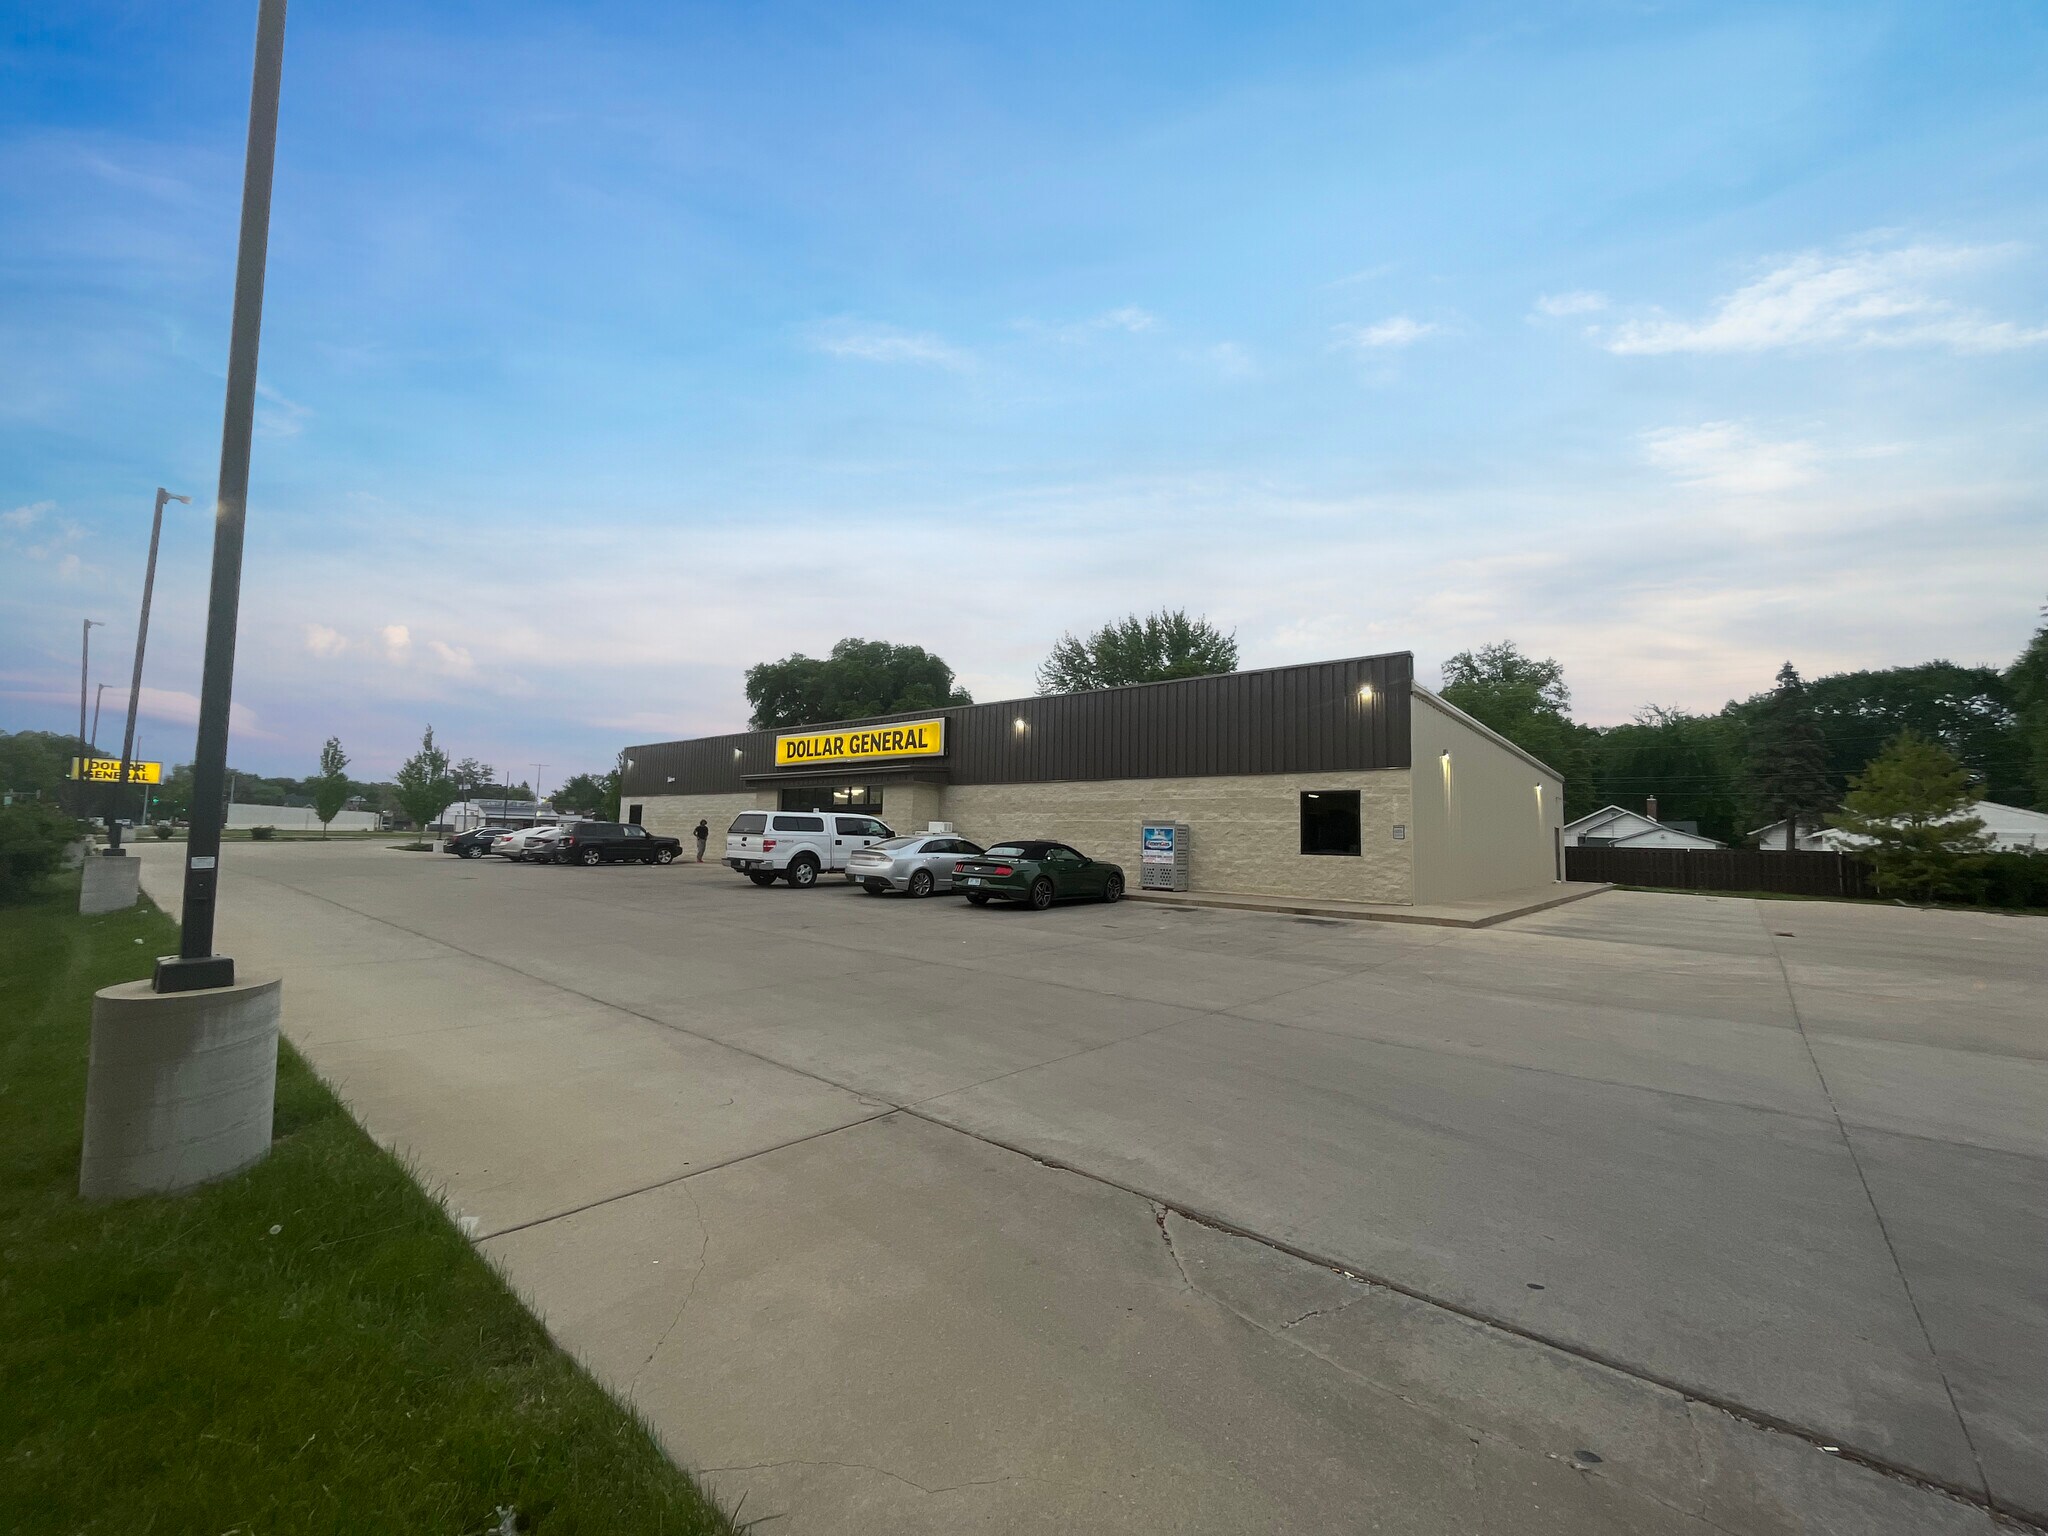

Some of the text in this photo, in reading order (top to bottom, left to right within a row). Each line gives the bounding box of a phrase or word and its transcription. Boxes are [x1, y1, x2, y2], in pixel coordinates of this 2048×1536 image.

[786, 728, 928, 758] DOLLAR GENERAL
[88, 770, 149, 781] GENEAL
